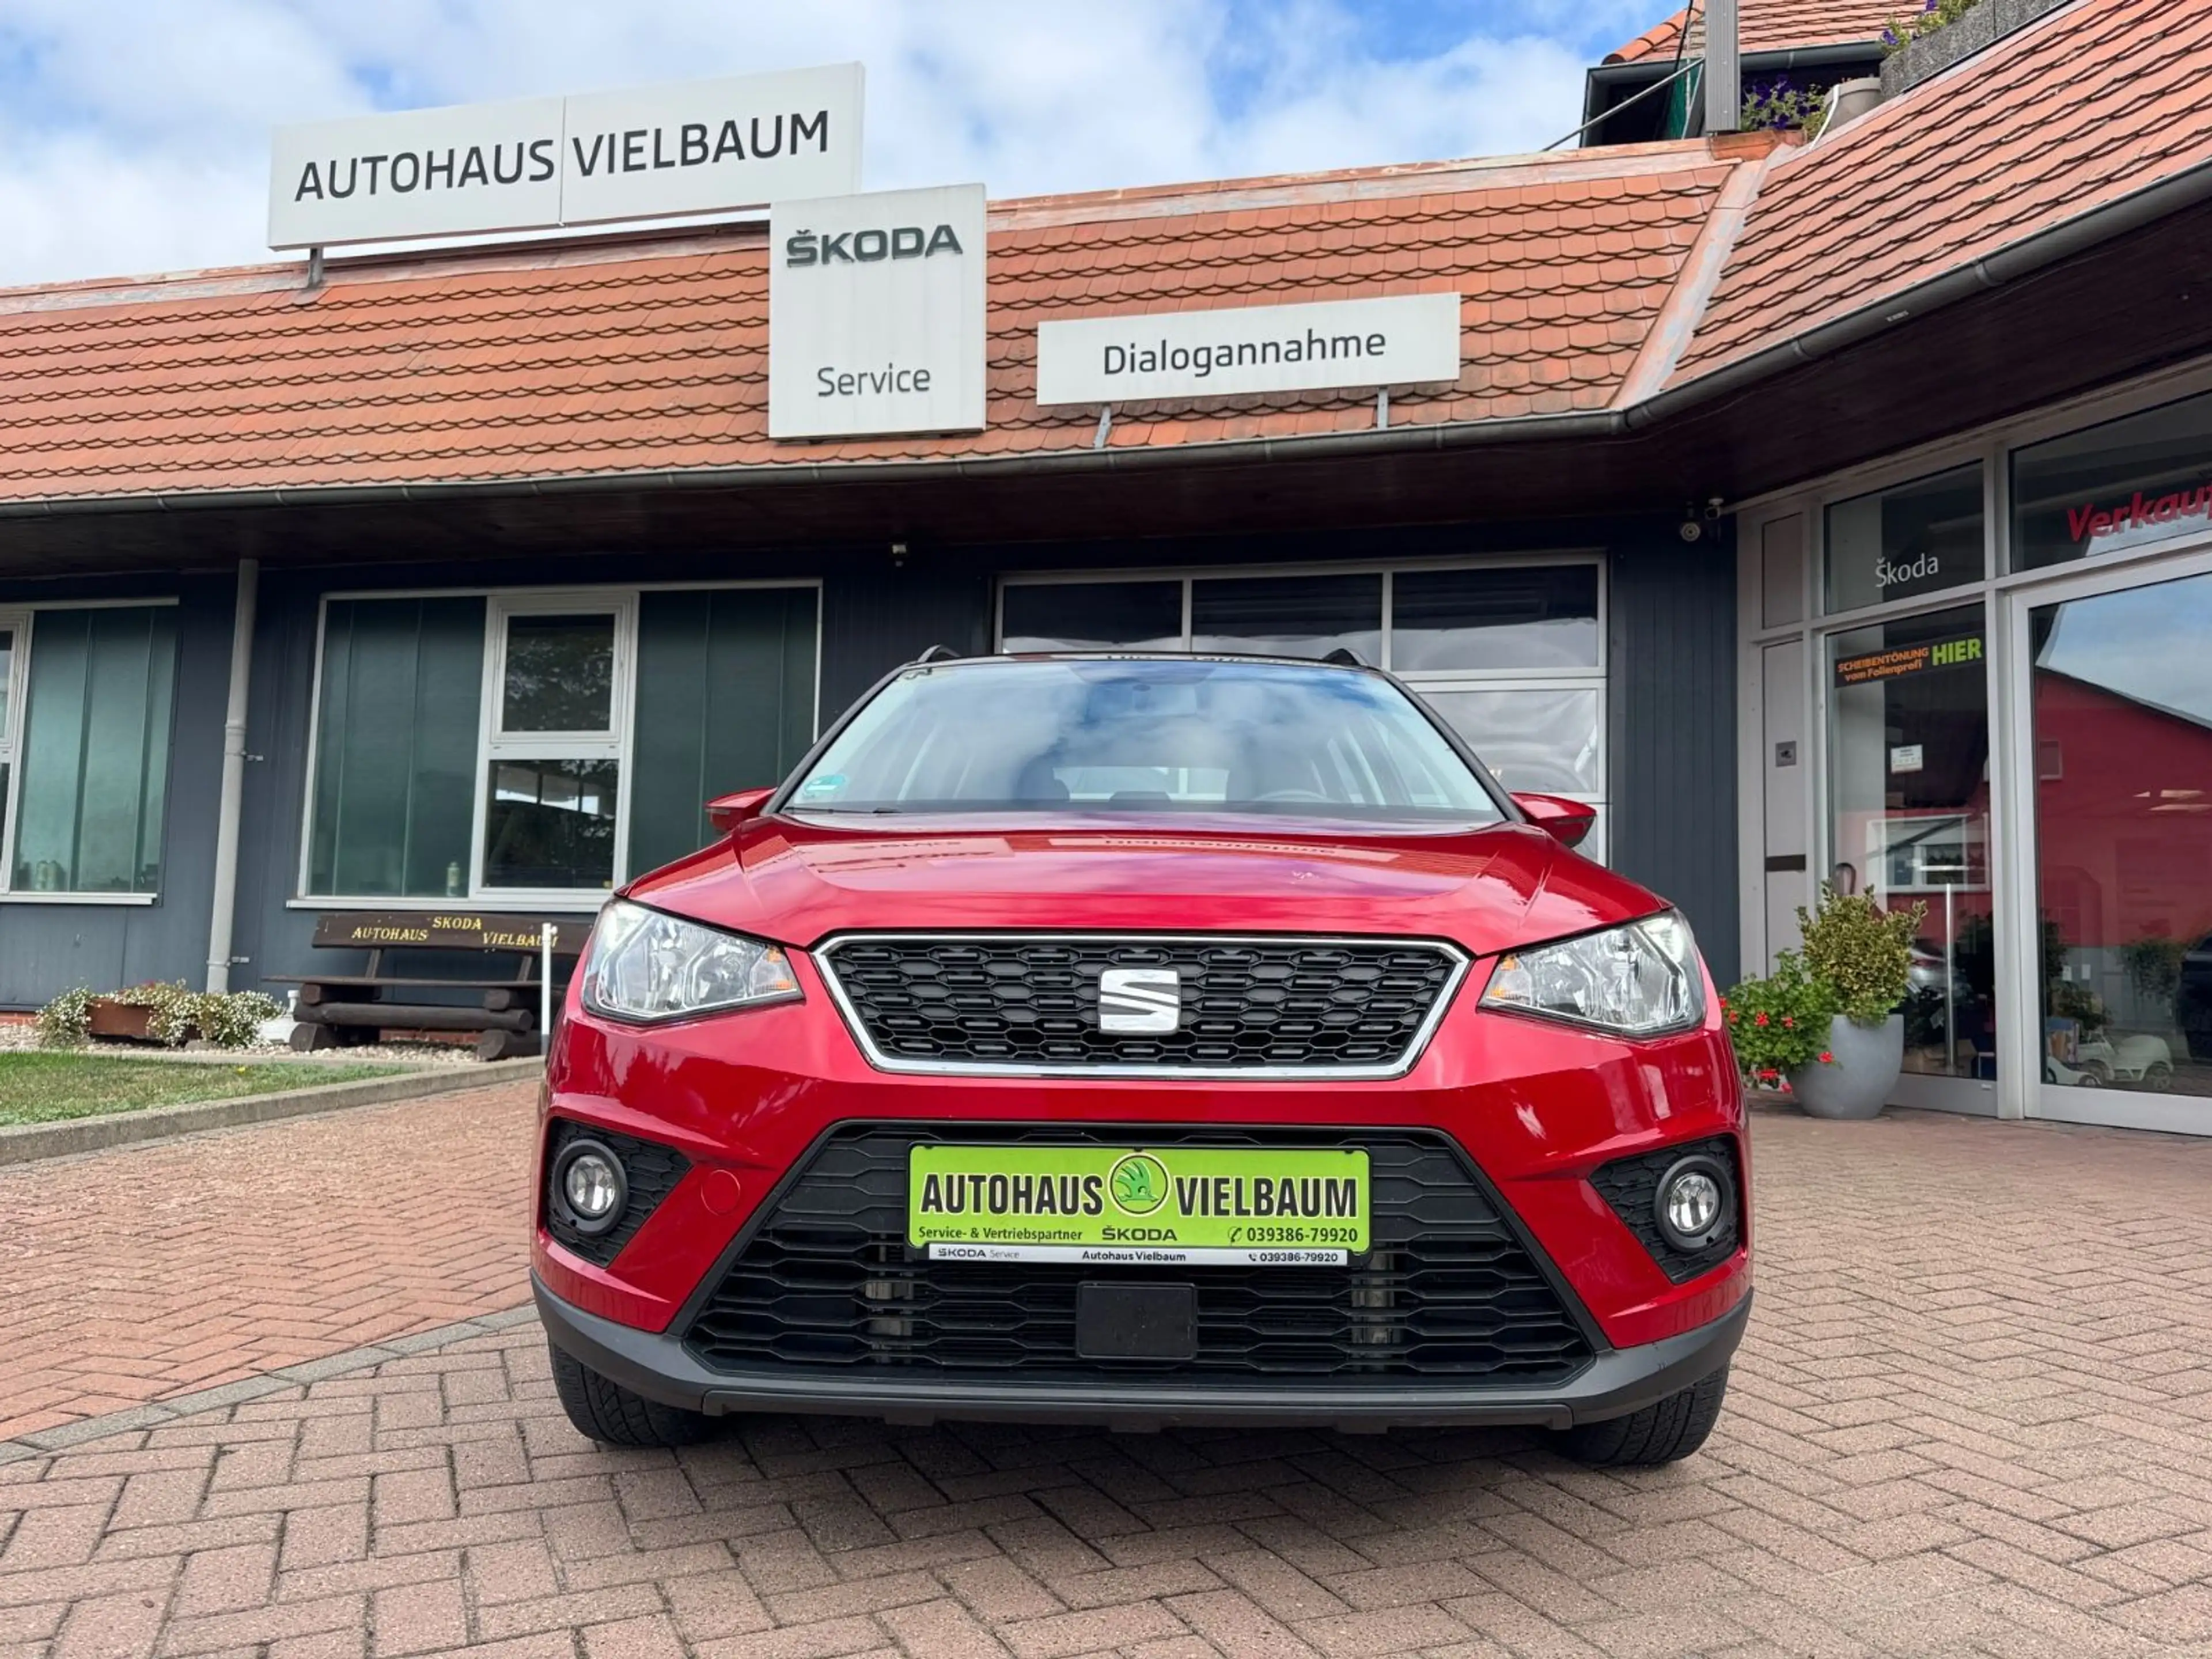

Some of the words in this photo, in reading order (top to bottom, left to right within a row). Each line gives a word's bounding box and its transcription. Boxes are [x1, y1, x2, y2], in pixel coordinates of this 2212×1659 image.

[294, 139, 554, 202] AUTOHAUS
[572, 110, 828, 177] VIELBAUM
[786, 225, 963, 268] ŠKODA
[1104, 328, 1385, 377] Dialogannahme
[817, 362, 930, 397] Service
[1875, 553, 1938, 588] Škoda
[1838, 647, 1929, 673] SCHEIBENTÖNUNG
[1932, 638, 1982, 666] HIER
[432, 916, 482, 930] SKODA
[351, 927, 428, 941] AUTOHAUS
[921, 1173, 1103, 1216] AUTOHAUS
[1175, 1176, 1357, 1218] VIELBAUM
[918, 1226, 967, 1239] Service-
[970, 1227, 980, 1238] &
[981, 1227, 1083, 1243] Vertriebspartner
[1101, 1225, 1178, 1241] ŠKODA
[1246, 1227, 1358, 1243] 039386-79920
[990, 1249, 1020, 1259] Service
[1082, 1250, 1134, 1260] Autohaus
[1135, 1251, 1186, 1262] Vielbaum
[1259, 1252, 1339, 1262] 039386-79920
